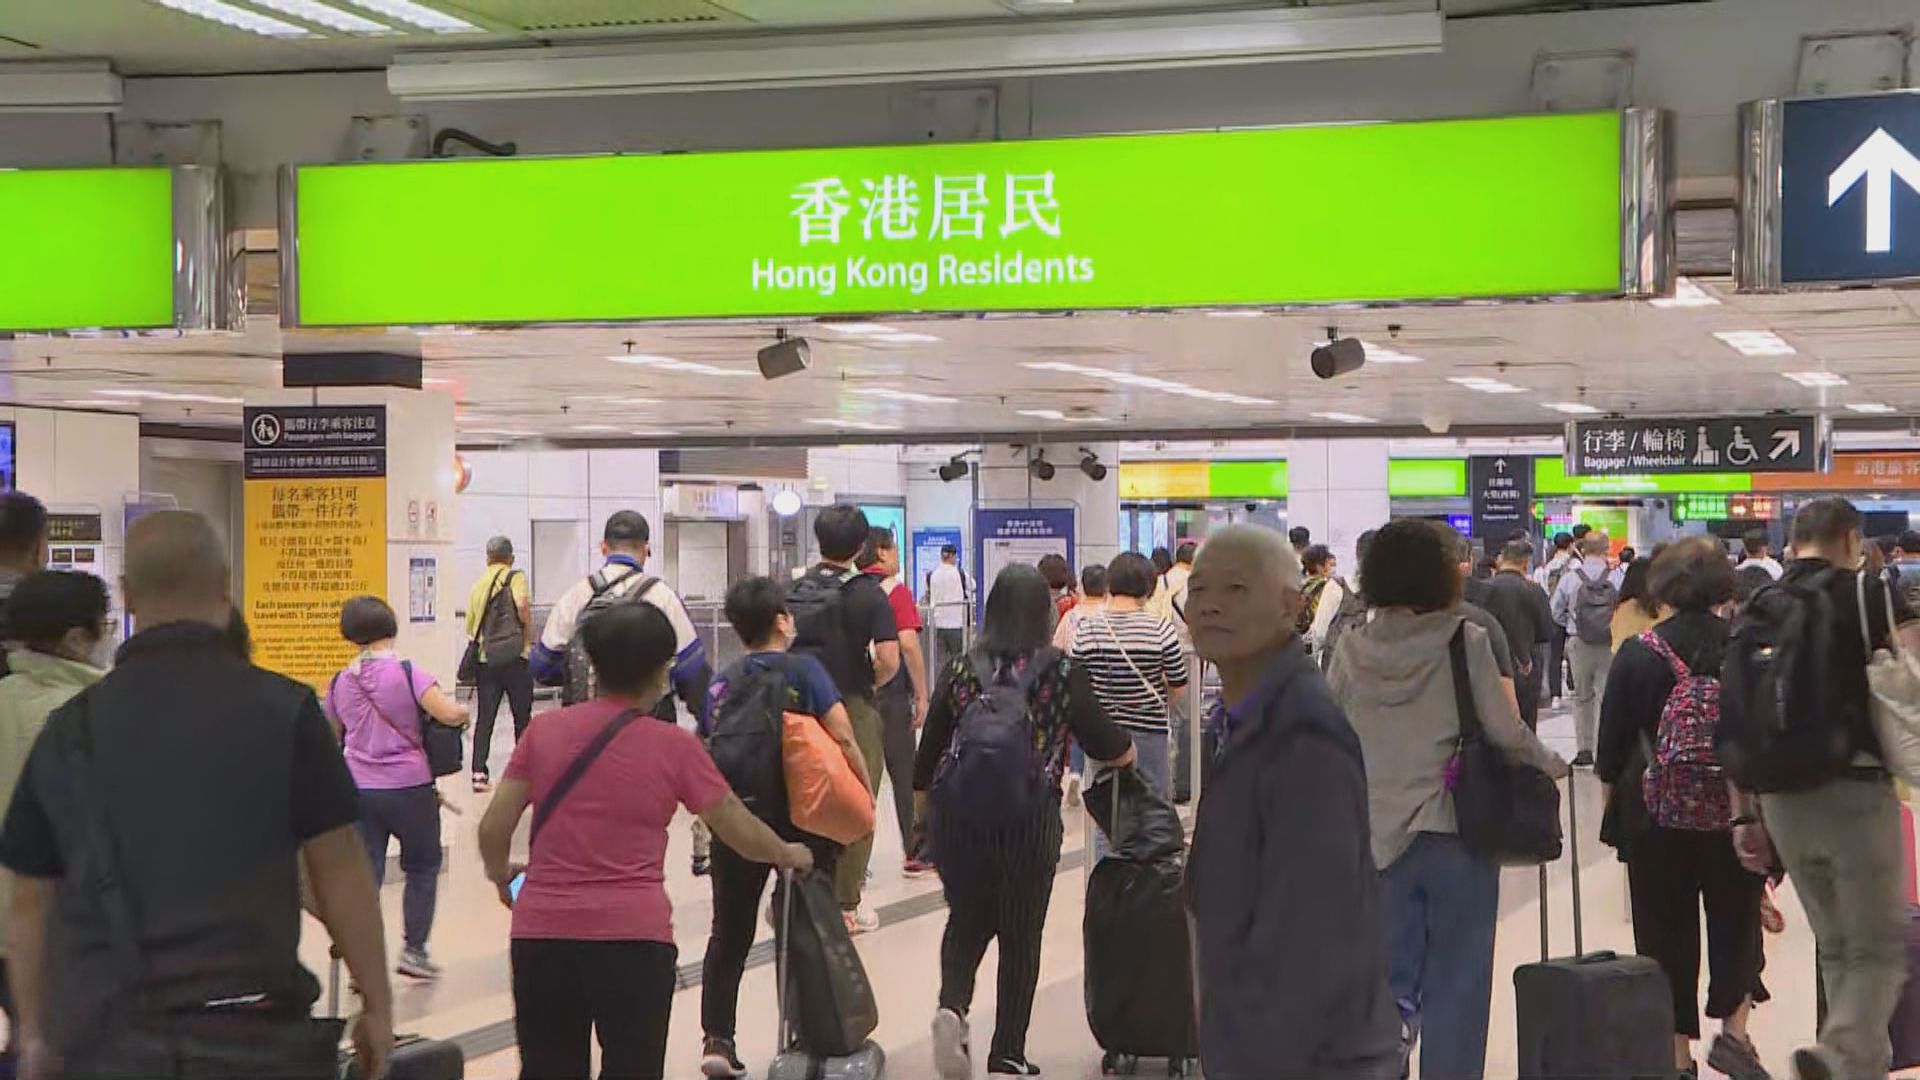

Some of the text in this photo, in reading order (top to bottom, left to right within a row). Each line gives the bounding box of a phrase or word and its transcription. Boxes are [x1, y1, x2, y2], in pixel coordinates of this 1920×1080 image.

[790, 170, 1062, 246] 香港居民
[752, 251, 1095, 296] Hong Kong Residents
[284, 432, 324, 442] Passengers
[343, 431, 376, 441] baggage
[1583, 428, 1625, 453] 行李
[1642, 428, 1687, 452] 輪椅
[1584, 456, 1625, 469] Baggage
[1633, 454, 1686, 466] Wheelchair
[272, 486, 358, 502] 每名乘客只可
[272, 503, 358, 519] 攜帶一件行李
[256, 600, 275, 609] Each
[277, 601, 320, 610] passenger
[254, 611, 277, 619] travel
[279, 611, 298, 619] with
